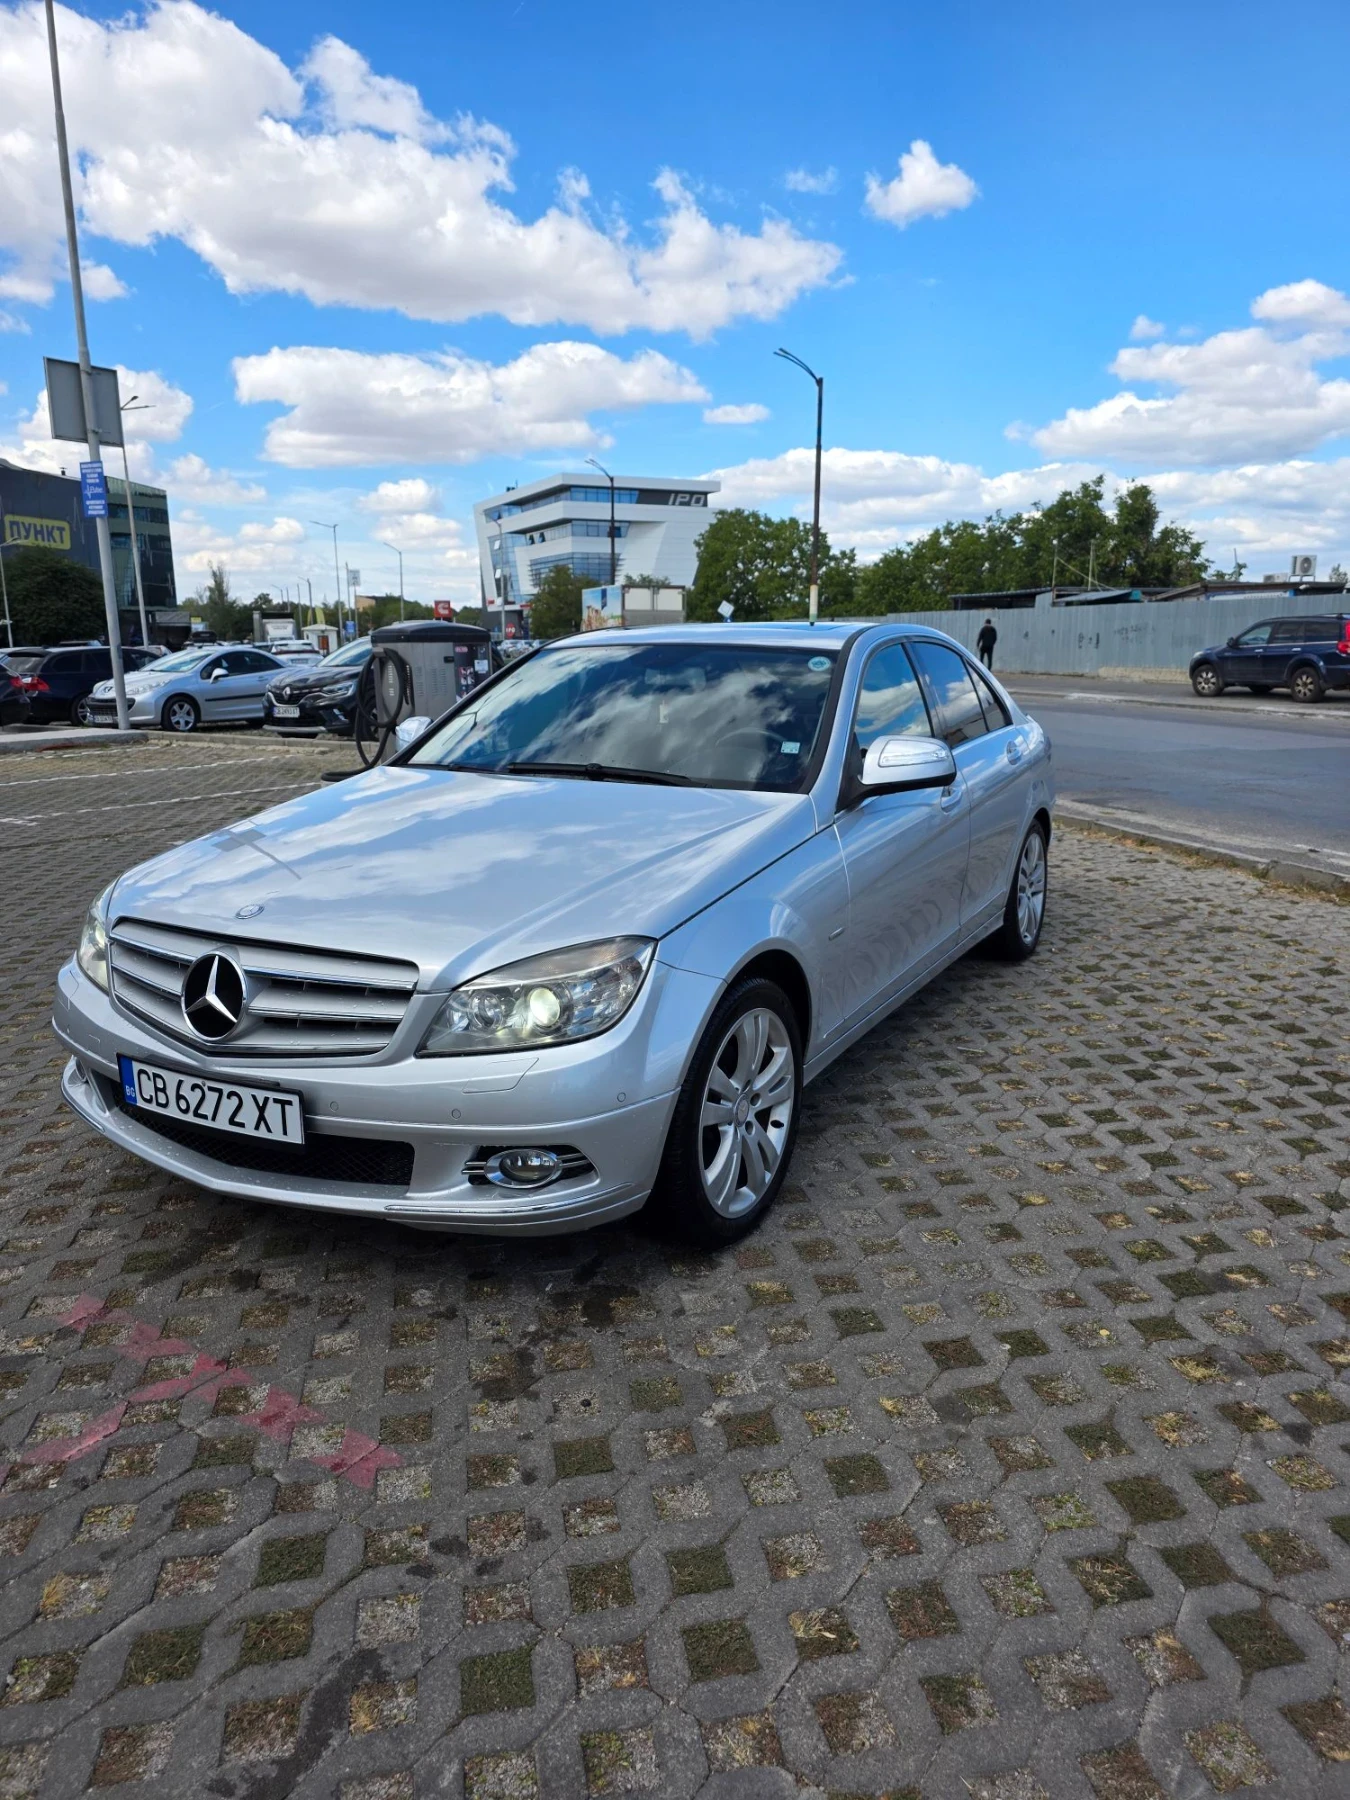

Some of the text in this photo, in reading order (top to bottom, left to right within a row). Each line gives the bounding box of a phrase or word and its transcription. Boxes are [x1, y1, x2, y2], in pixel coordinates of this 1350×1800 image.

[668, 493, 706, 507] IPO
[9, 520, 65, 544] ПУНКТ
[125, 1085, 136, 1098] BG
[136, 1068, 293, 1136] CB 6272 XT
